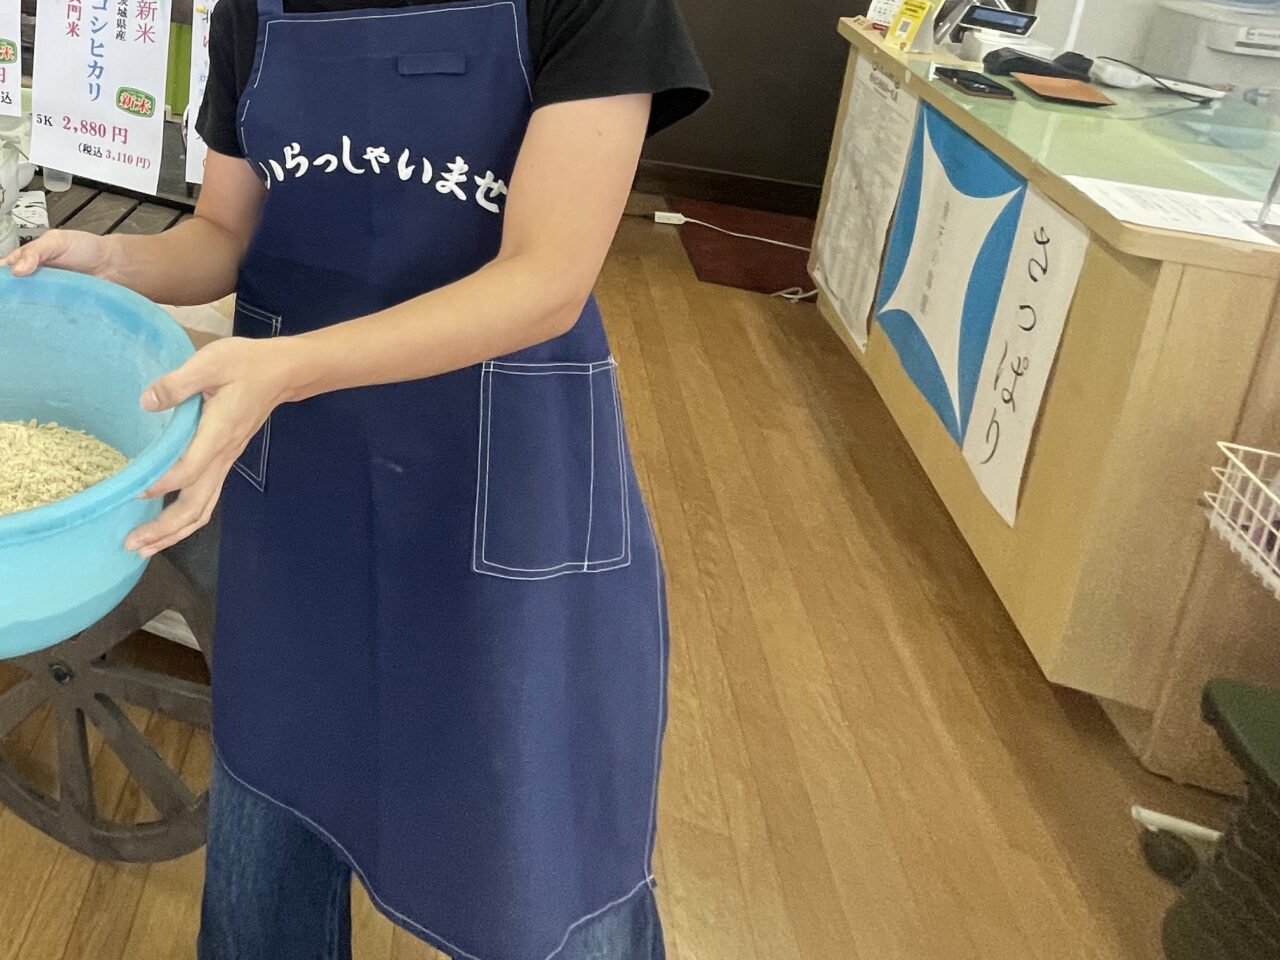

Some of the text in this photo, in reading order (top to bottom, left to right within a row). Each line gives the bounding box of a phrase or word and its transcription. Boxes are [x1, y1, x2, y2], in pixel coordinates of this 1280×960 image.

[119, 92, 152, 115] 新米
[36, 113, 54, 127] 5K
[259, 135, 508, 214] いらっしゃいませ
